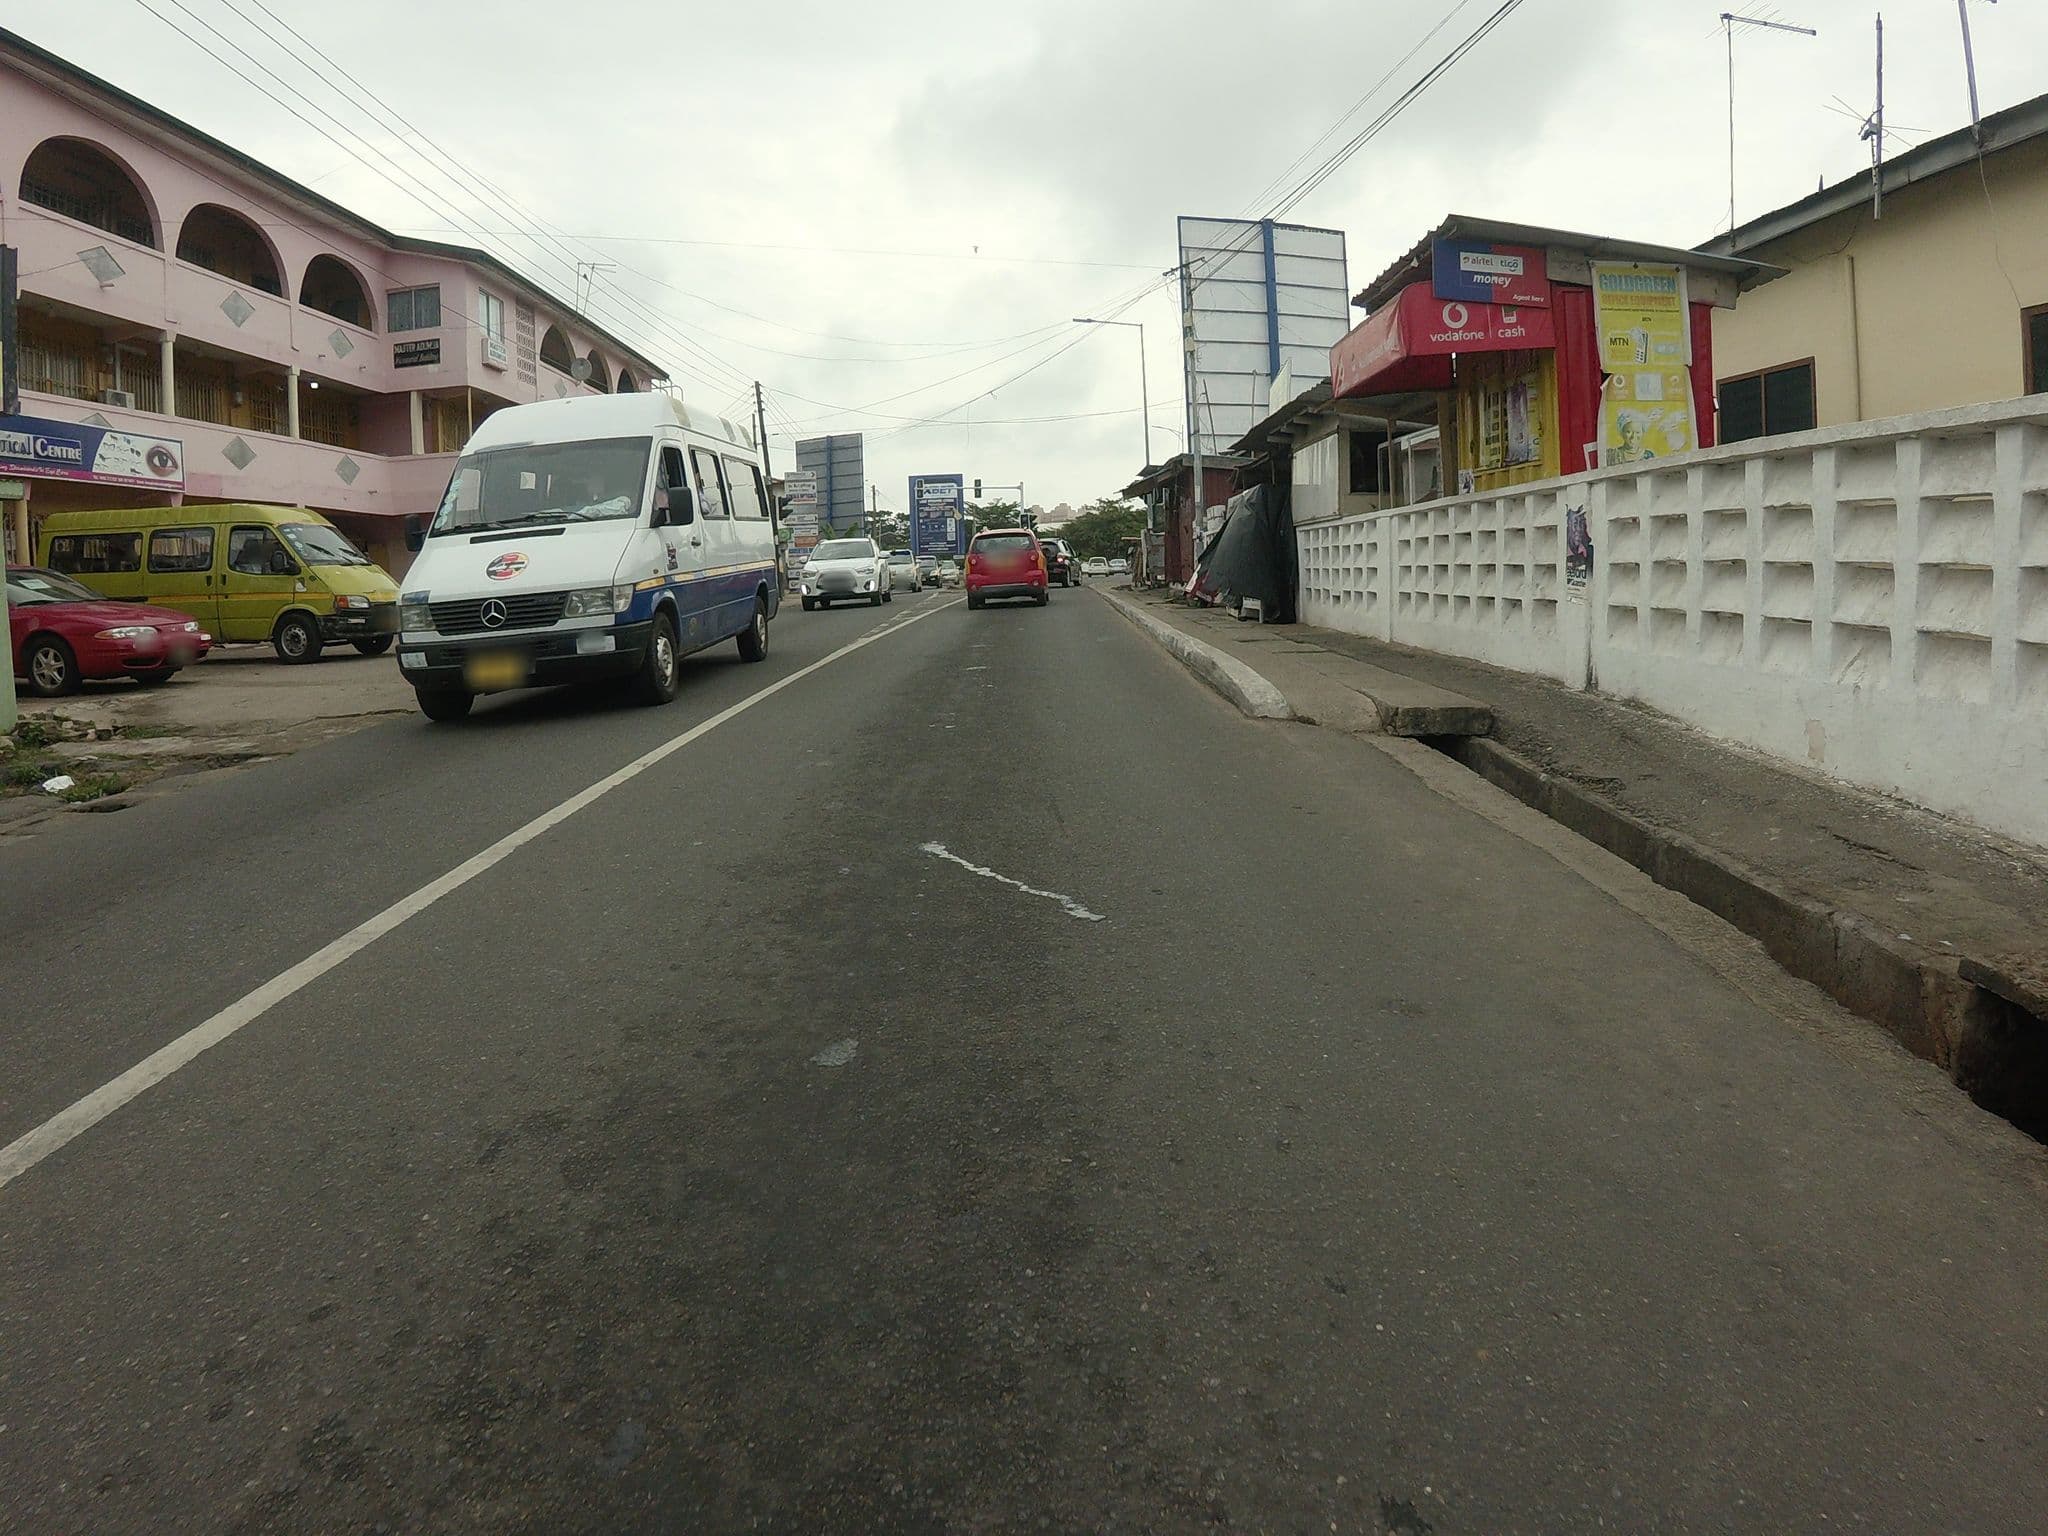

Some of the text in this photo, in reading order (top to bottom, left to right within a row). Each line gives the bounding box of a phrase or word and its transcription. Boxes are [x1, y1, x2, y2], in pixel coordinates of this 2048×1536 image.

[1471, 256, 1519, 271] airtel tigo
[1473, 274, 1512, 288] money
[1430, 326, 1526, 342] vodafone cash
[1609, 337, 1629, 347] MTN
[35, 438, 82, 460] CENTRE
